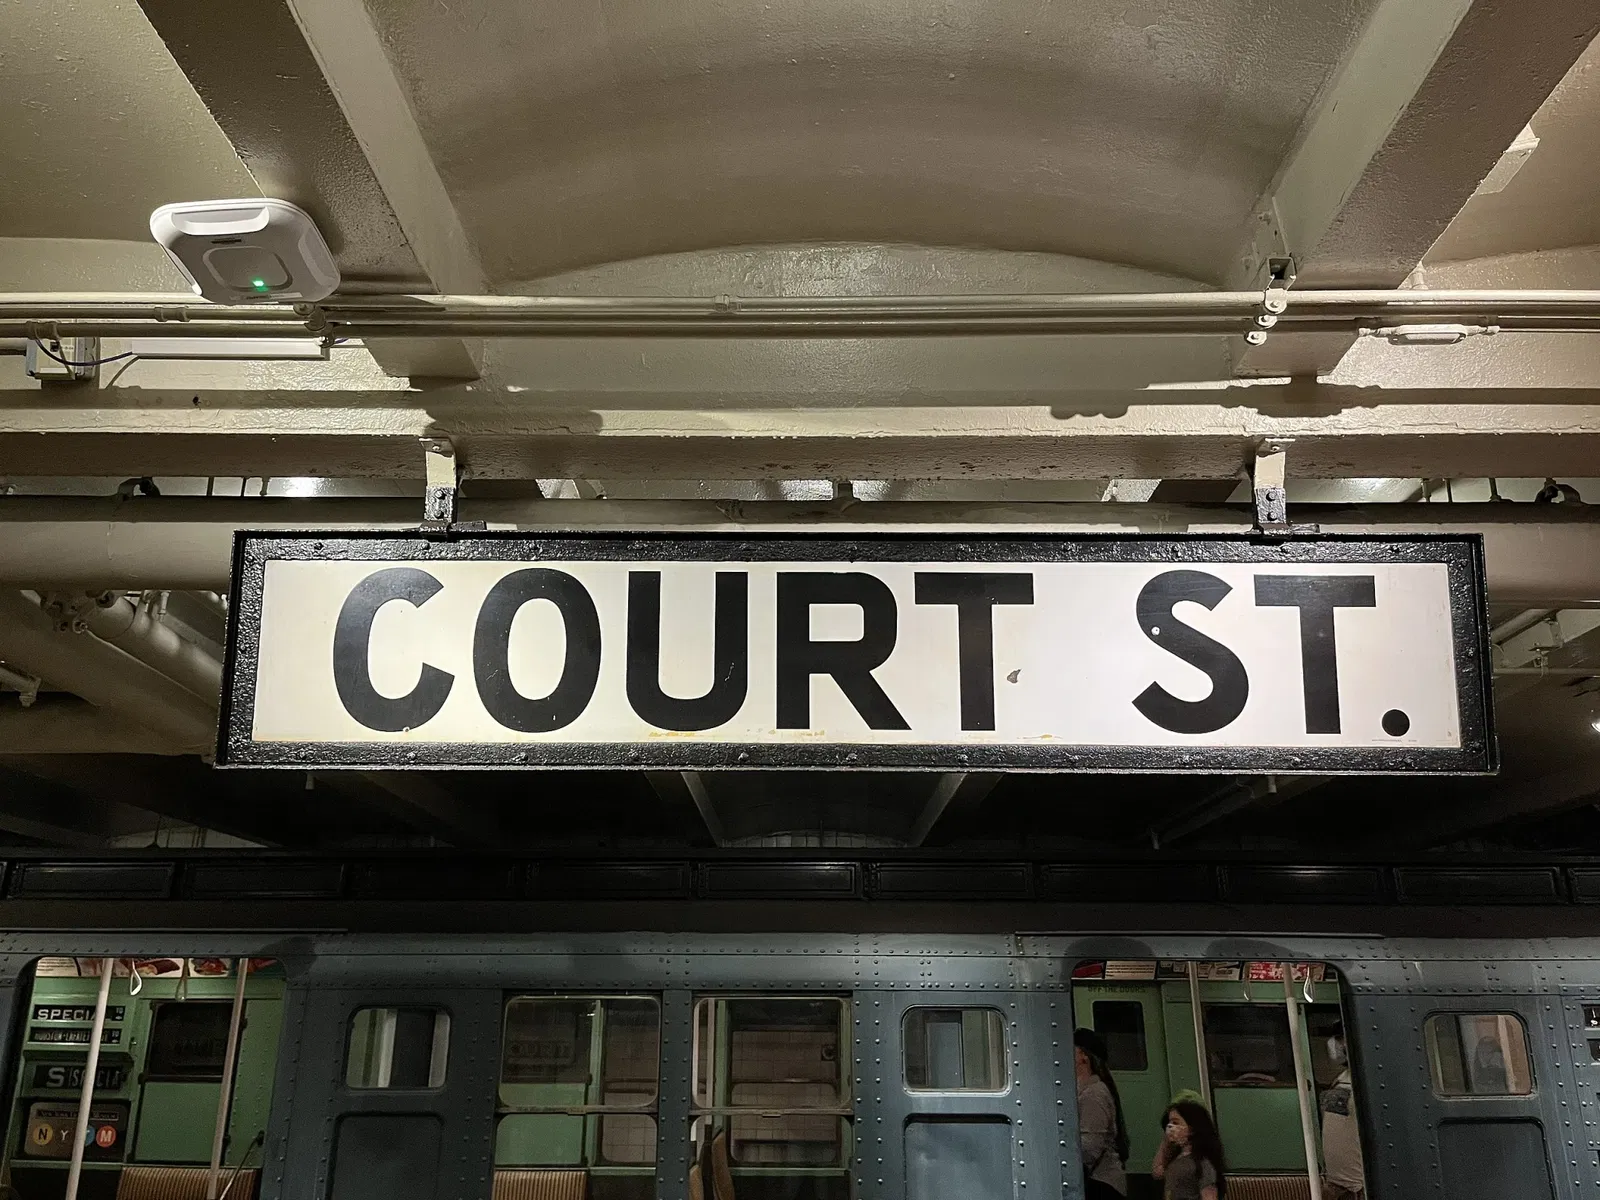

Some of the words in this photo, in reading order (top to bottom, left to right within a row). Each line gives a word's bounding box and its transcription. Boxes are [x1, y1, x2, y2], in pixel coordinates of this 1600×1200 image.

[333, 567, 1034, 733] COURT
[1132, 569, 1410, 737] ST.
[37, 1008, 112, 1020] SPECI
[46, 1067, 65, 1087] S
[38, 1128, 48, 1141] N
[61, 1129, 69, 1141] Y
[100, 1129, 113, 1142] M
